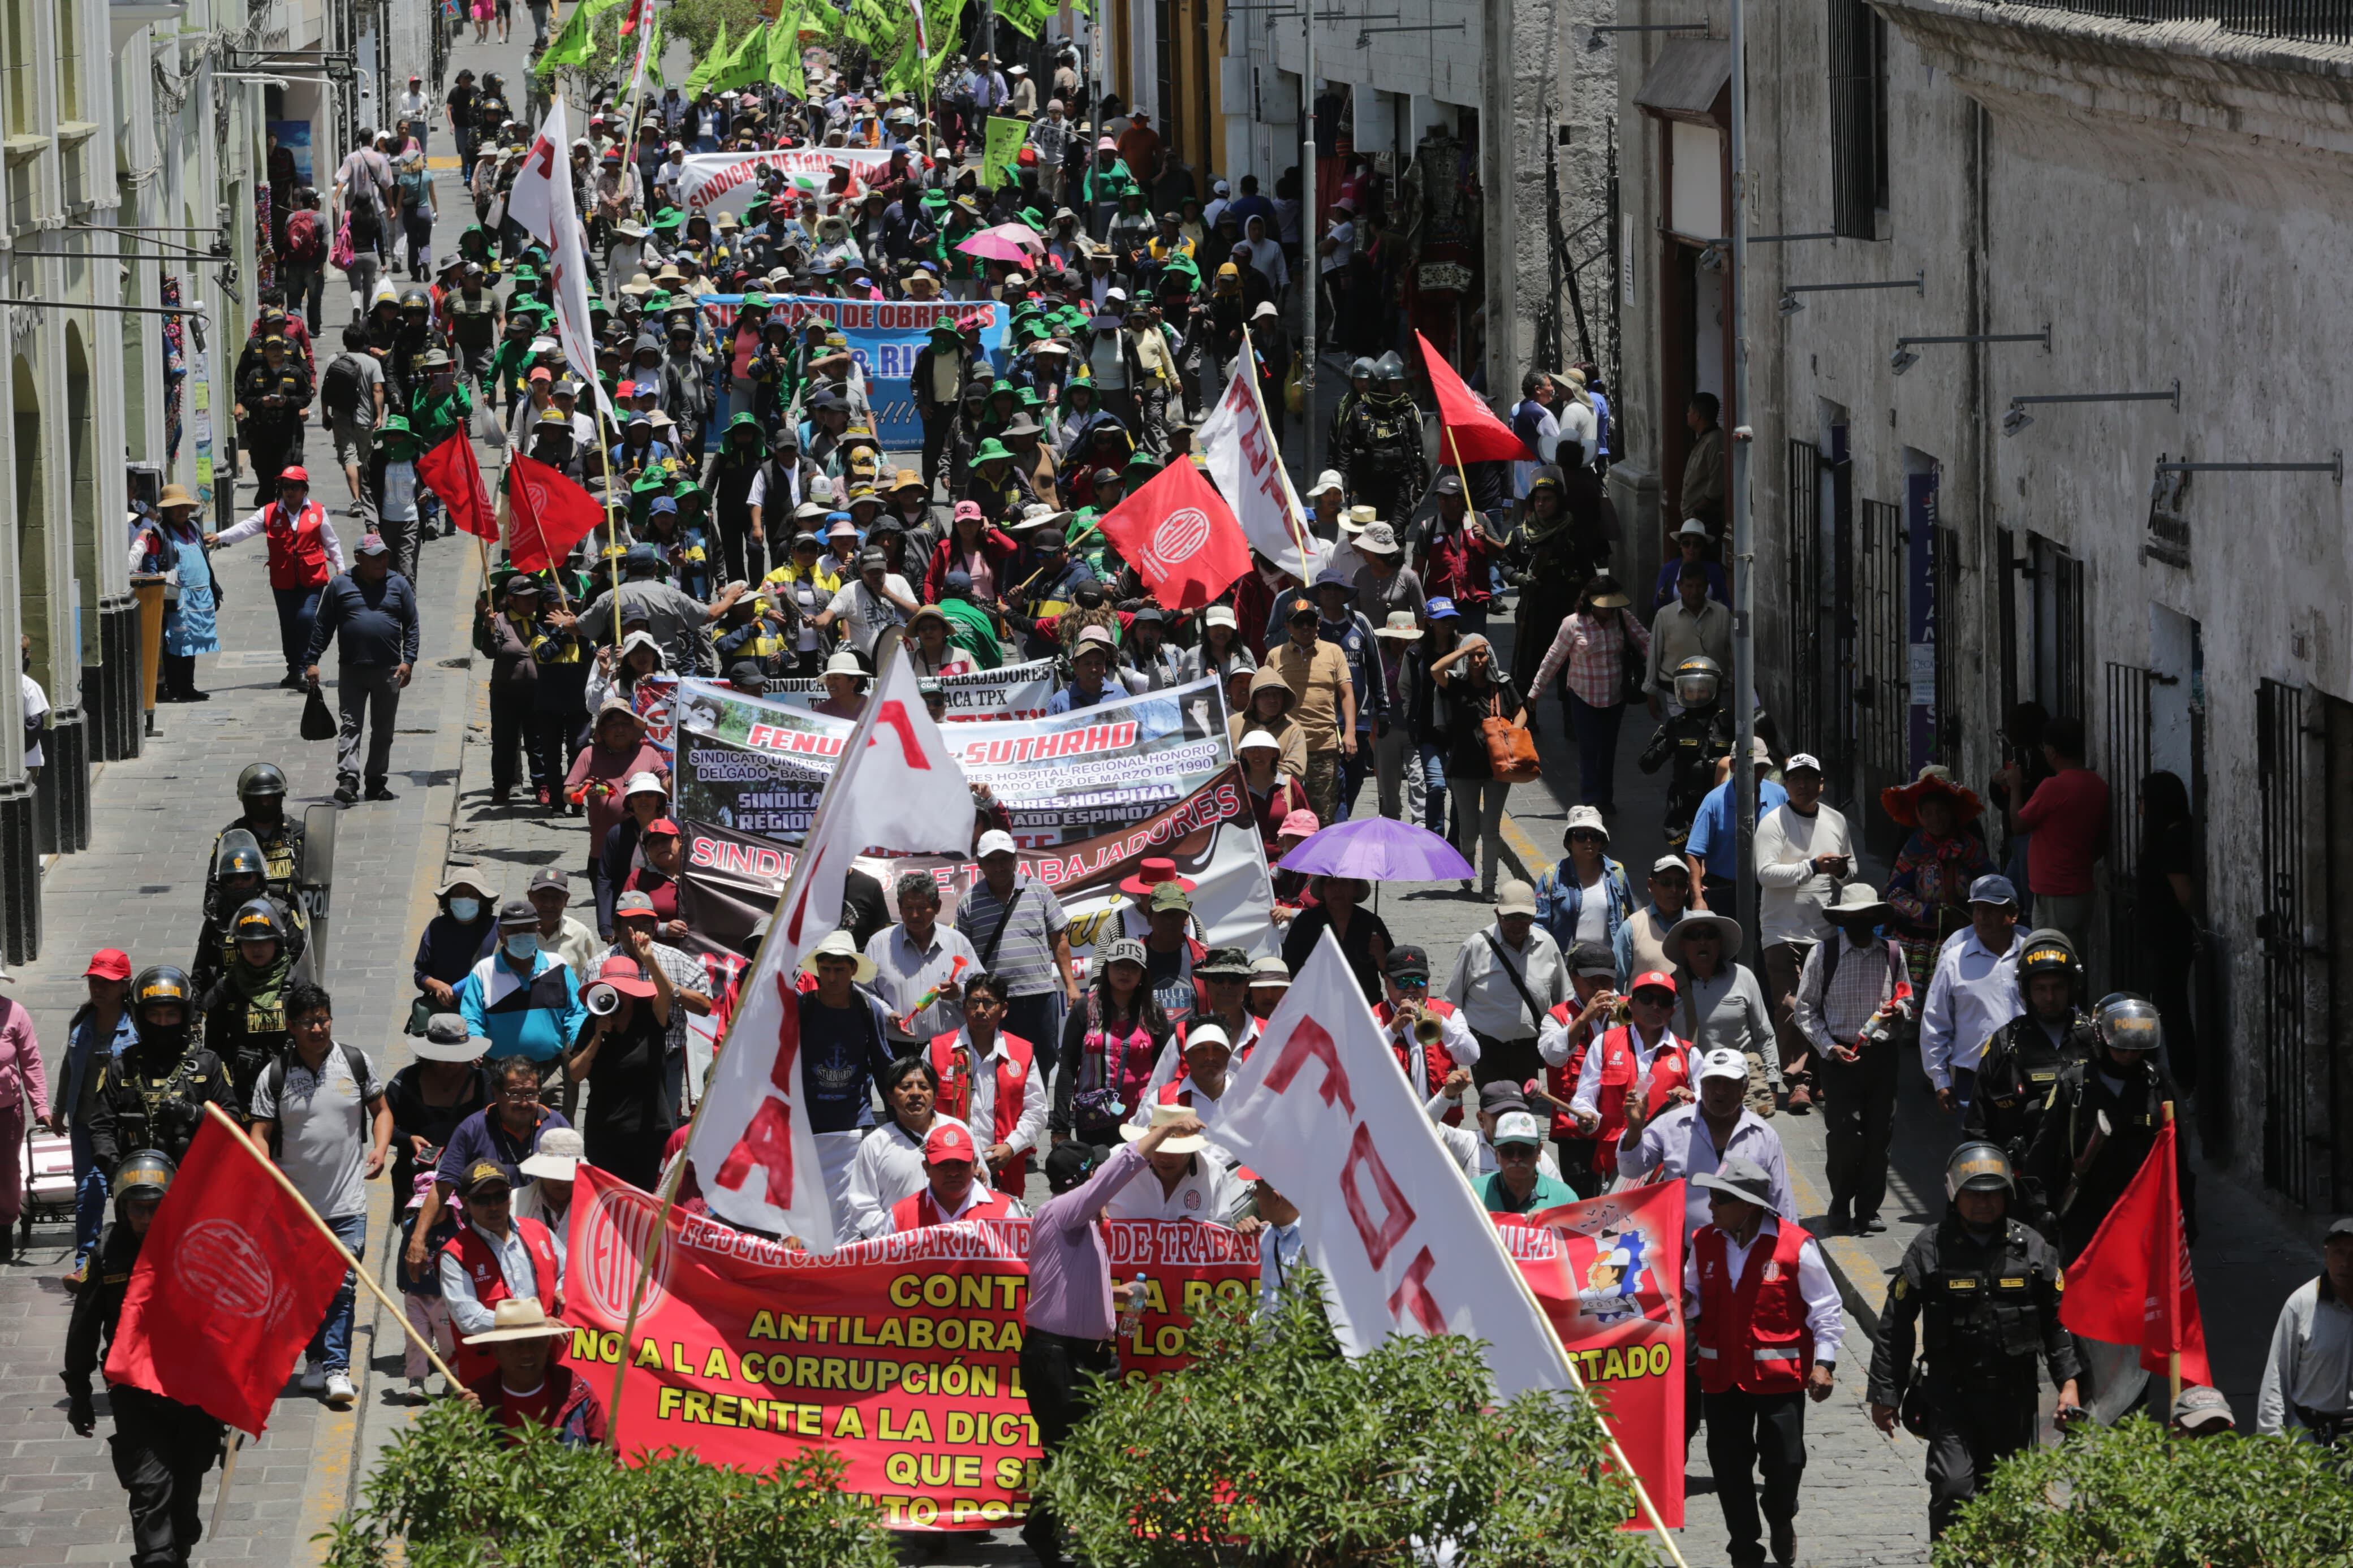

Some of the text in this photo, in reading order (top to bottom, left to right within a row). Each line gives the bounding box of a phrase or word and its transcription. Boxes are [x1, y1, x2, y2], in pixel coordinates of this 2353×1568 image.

[772, 154, 792, 171] DE
[842, 304, 874, 329] DE
[878, 304, 996, 329] OBREROS
[880, 344, 924, 380] RI
[762, 678, 829, 693] SINDICA
[943, 691, 971, 707] ACA
[975, 689, 1007, 707] TPX
[748, 724, 844, 757] FENU
[691, 743, 1218, 783] SINDICATO UNIFICA RES HOSPITAL REGIONAL HONORIO
[699, 767, 768, 779] DELGADO
[780, 770, 817, 781] BASE
[991, 781, 1030, 792] DADO
[1036, 780, 1054, 789] EL
[1057, 778, 1072, 788] 23
[1078, 775, 1096, 785] DE
[1100, 768, 1151, 783] MARZO
[1156, 765, 1174, 776] DE
[1178, 758, 1212, 772] 1990
[738, 792, 821, 809] SINDICA
[1068, 784, 1178, 807] HOSPITAL
[739, 813, 816, 830] REGION
[1012, 809, 1060, 827] ADO
[960, 784, 1240, 889] TABAJADORES
[268, 861, 291, 877] OLICIA
[302, 889, 329, 919] POL
[239, 915, 270, 928] POLICIA
[1116, 944, 1143, 960] BTS
[2027, 950, 2067, 965] POLICIA
[143, 986, 182, 999] POLICIA
[818, 1068, 851, 1082] STARBOARD
[862, 1219, 1029, 1266] DEPARTAME
[1110, 1224, 1153, 1264] DE
[1157, 1223, 1261, 1266] TRABAJ
[889, 1273, 1031, 1311] CONT
[1587, 1297, 1622, 1310] CGTP
[748, 1309, 1024, 1353] ANTILABORA
[571, 1327, 624, 1366] NO
[634, 1338, 665, 1371] A
[739, 1355, 999, 1399] CORRUPCIÓN
[1566, 1341, 1671, 1383] STADO
[657, 1385, 1041, 1448] FRENTE A LA DICT
[885, 1452, 984, 1488] QUE
